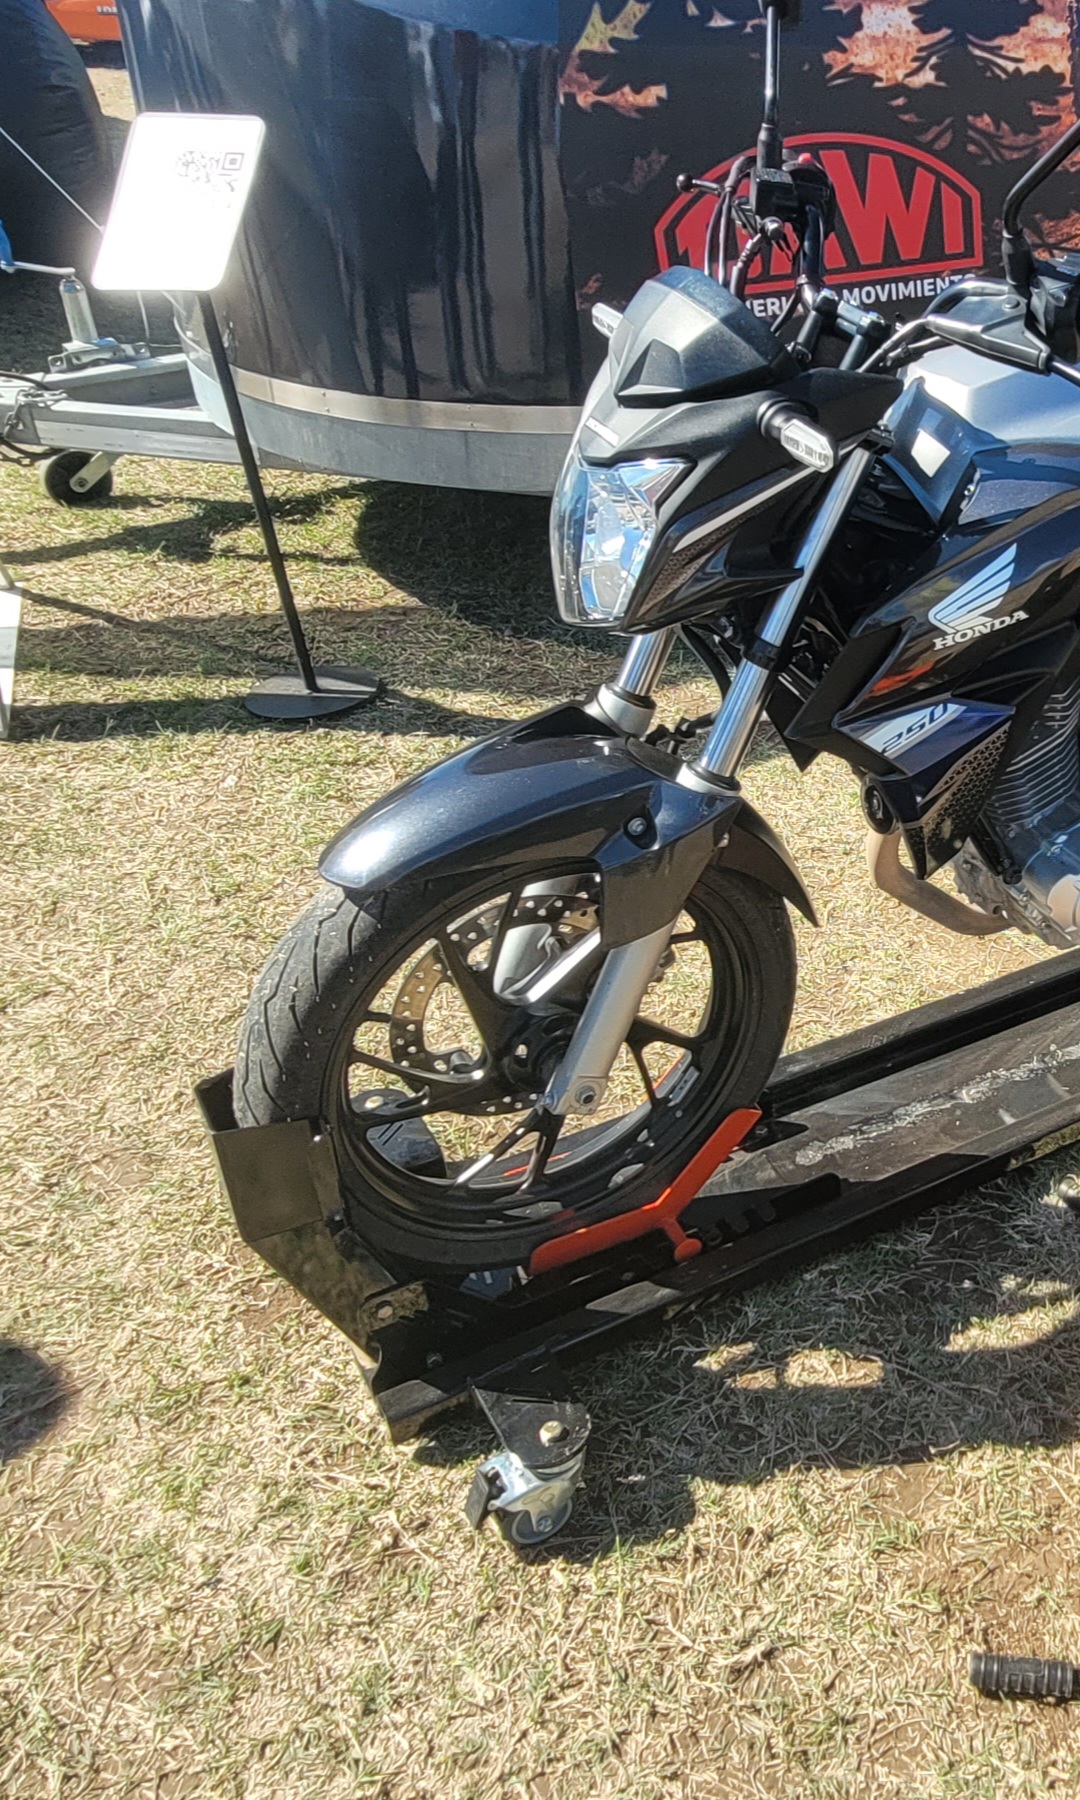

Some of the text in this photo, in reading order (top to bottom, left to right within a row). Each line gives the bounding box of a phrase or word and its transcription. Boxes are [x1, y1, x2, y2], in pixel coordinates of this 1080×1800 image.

[842, 273, 977, 304] MOVIMIENT
[933, 610, 1029, 651] HONDA
[882, 702, 949, 754] 250
